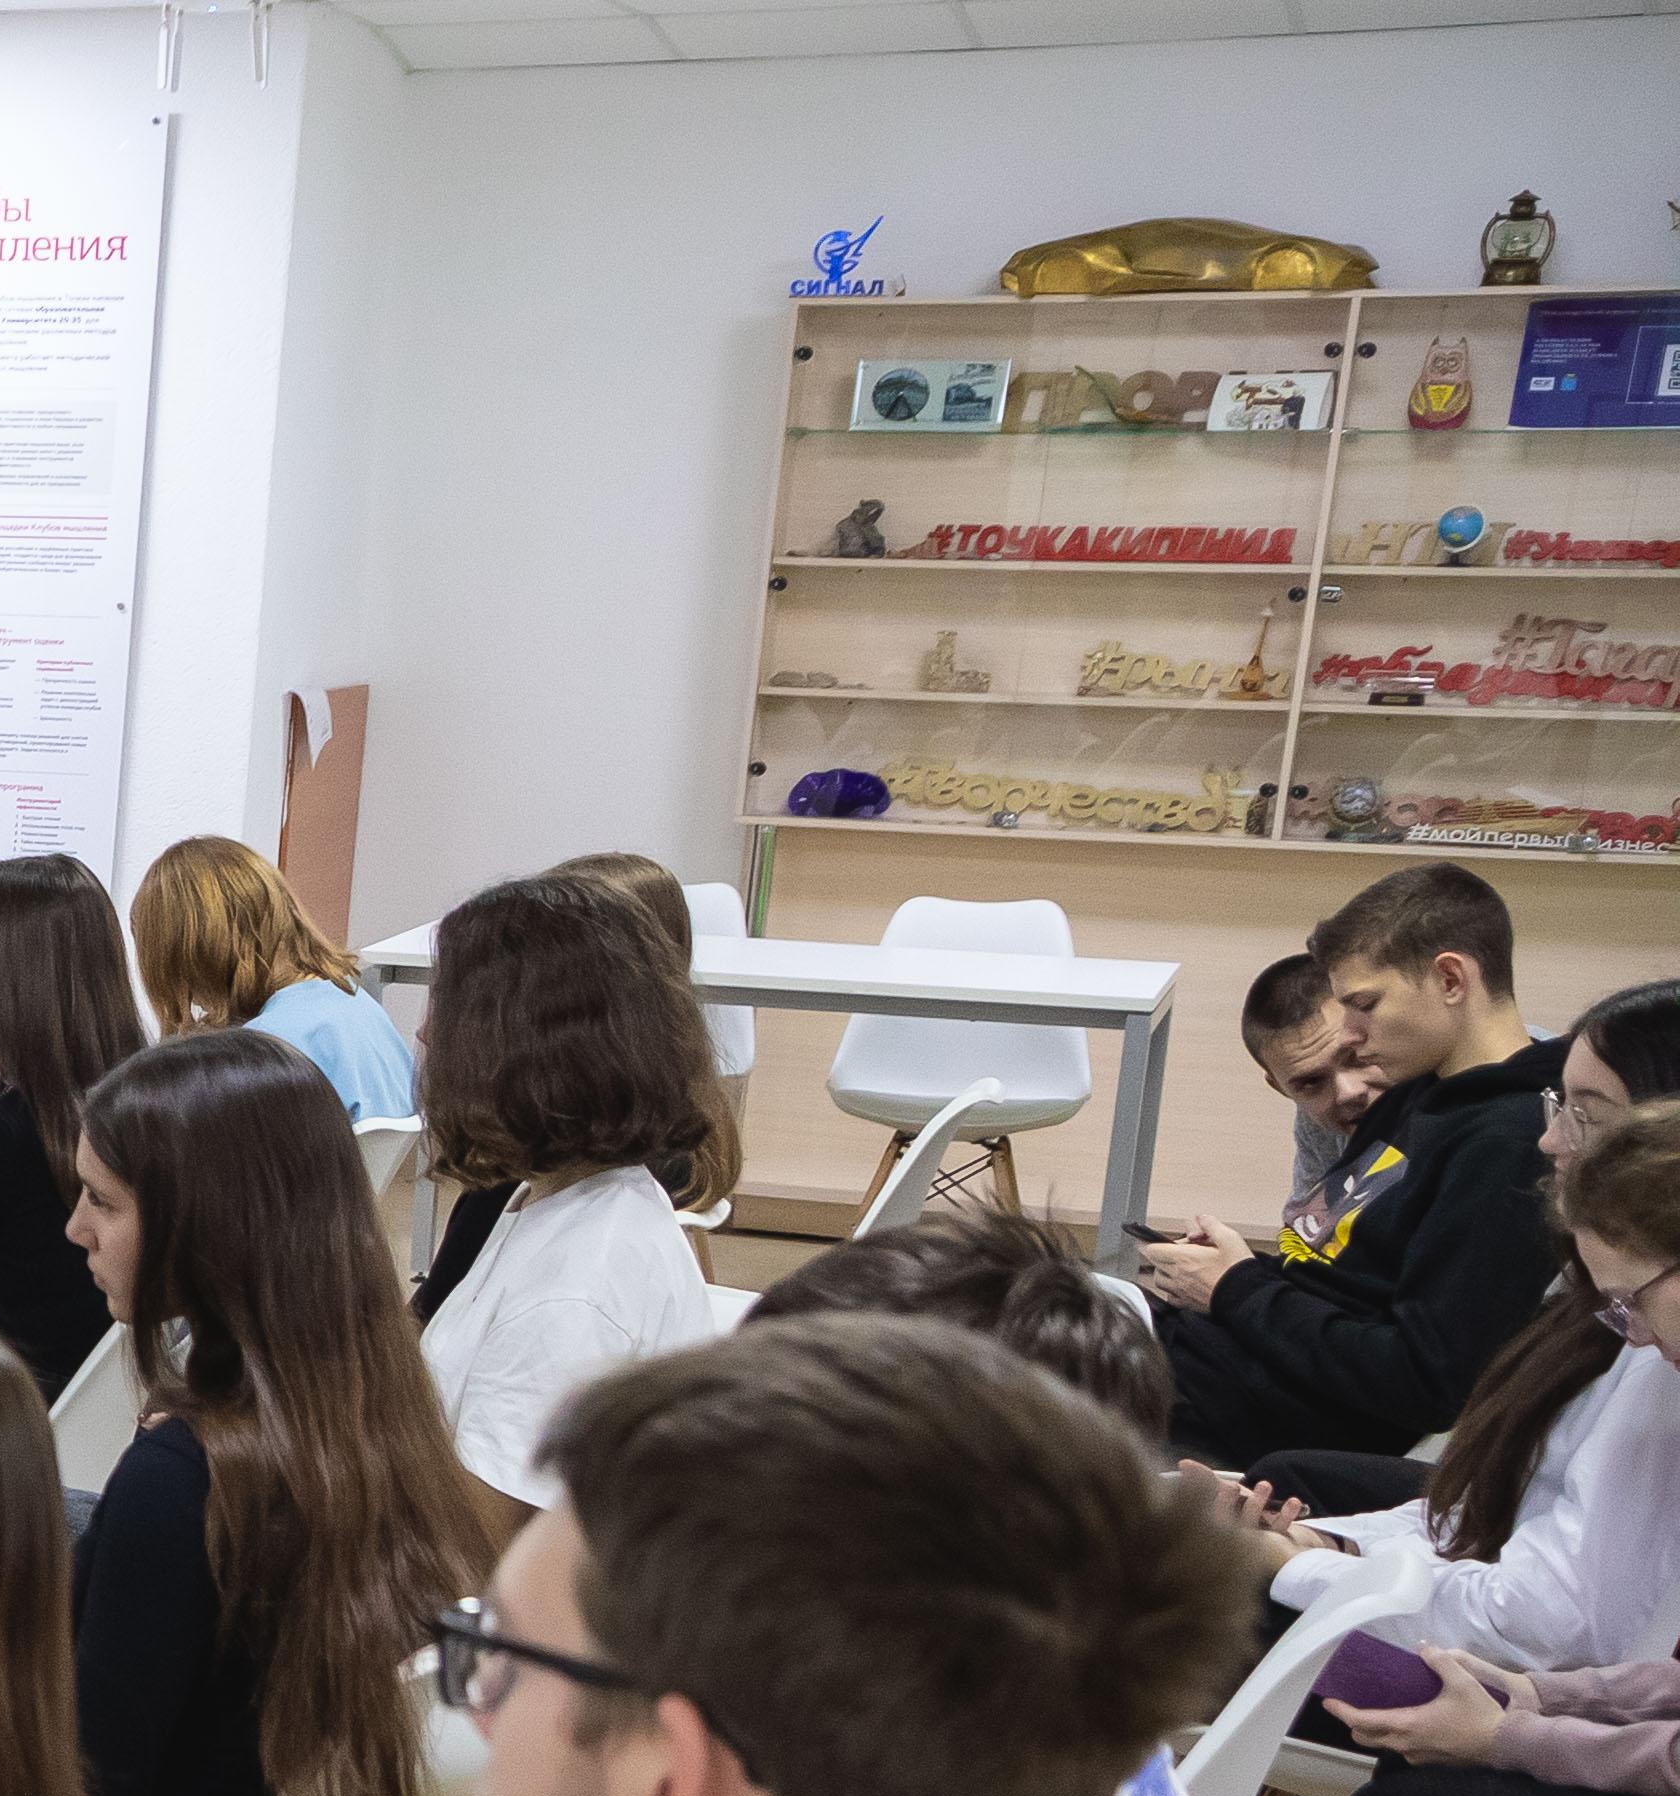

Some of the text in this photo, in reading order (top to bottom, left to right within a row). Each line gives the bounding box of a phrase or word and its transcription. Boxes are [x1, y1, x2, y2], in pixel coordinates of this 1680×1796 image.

[789, 279, 884, 297] СИГНАЛ
[927, 524, 1298, 563] #ТОЧКАКИПЕНИЯ
[0, 782, 43, 793] программа
[1407, 824, 1673, 853] #мойпервыизнес
